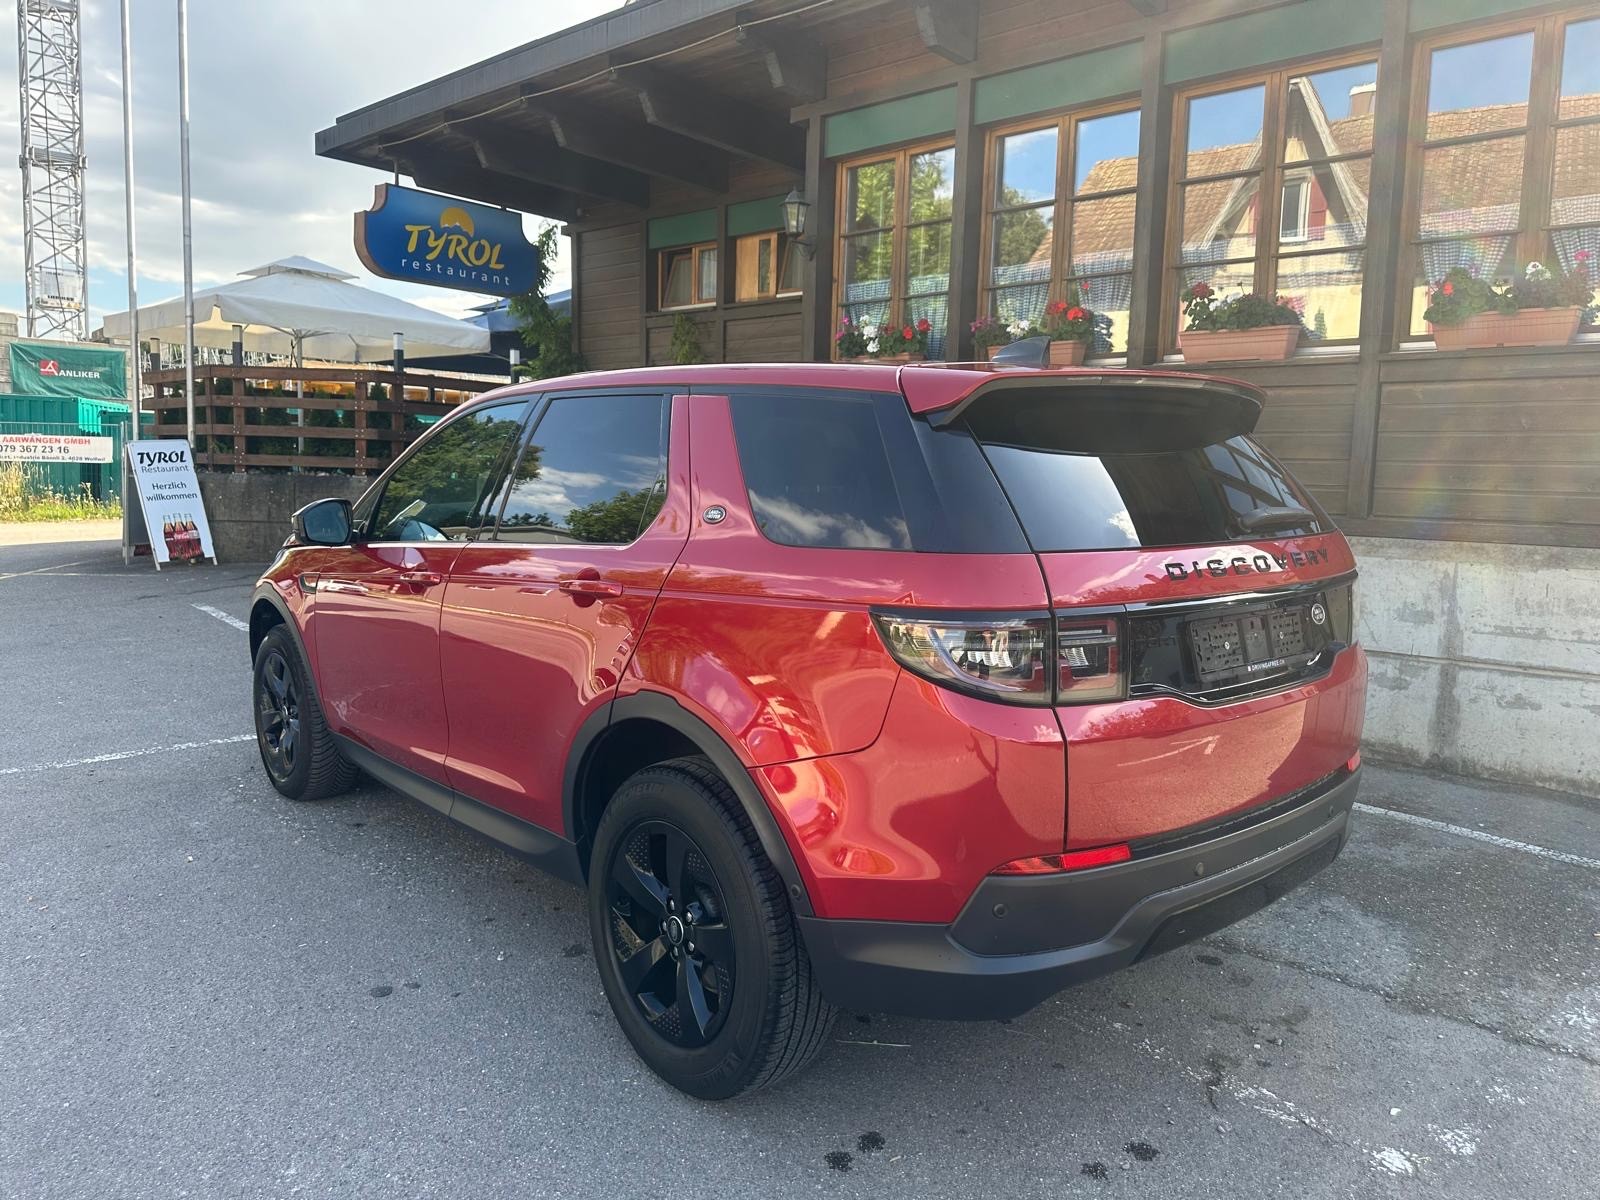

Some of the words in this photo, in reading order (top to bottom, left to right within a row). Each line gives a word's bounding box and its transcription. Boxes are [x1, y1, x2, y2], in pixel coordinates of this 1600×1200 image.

[405, 224, 505, 270] TYROL
[401, 258, 510, 286] restaurant
[58, 369, 100, 379] ANLIKER
[64, 437, 91, 445] GMBH
[19, 445, 38, 453] 367
[41, 445, 54, 454] 23
[57, 446, 70, 454] 16
[137, 450, 187, 466] TYROL
[141, 464, 190, 474] Restaurant
[152, 481, 187, 491] Herzlich
[146, 491, 198, 502] willkommen
[1164, 547, 1329, 581] DISCOVERY
